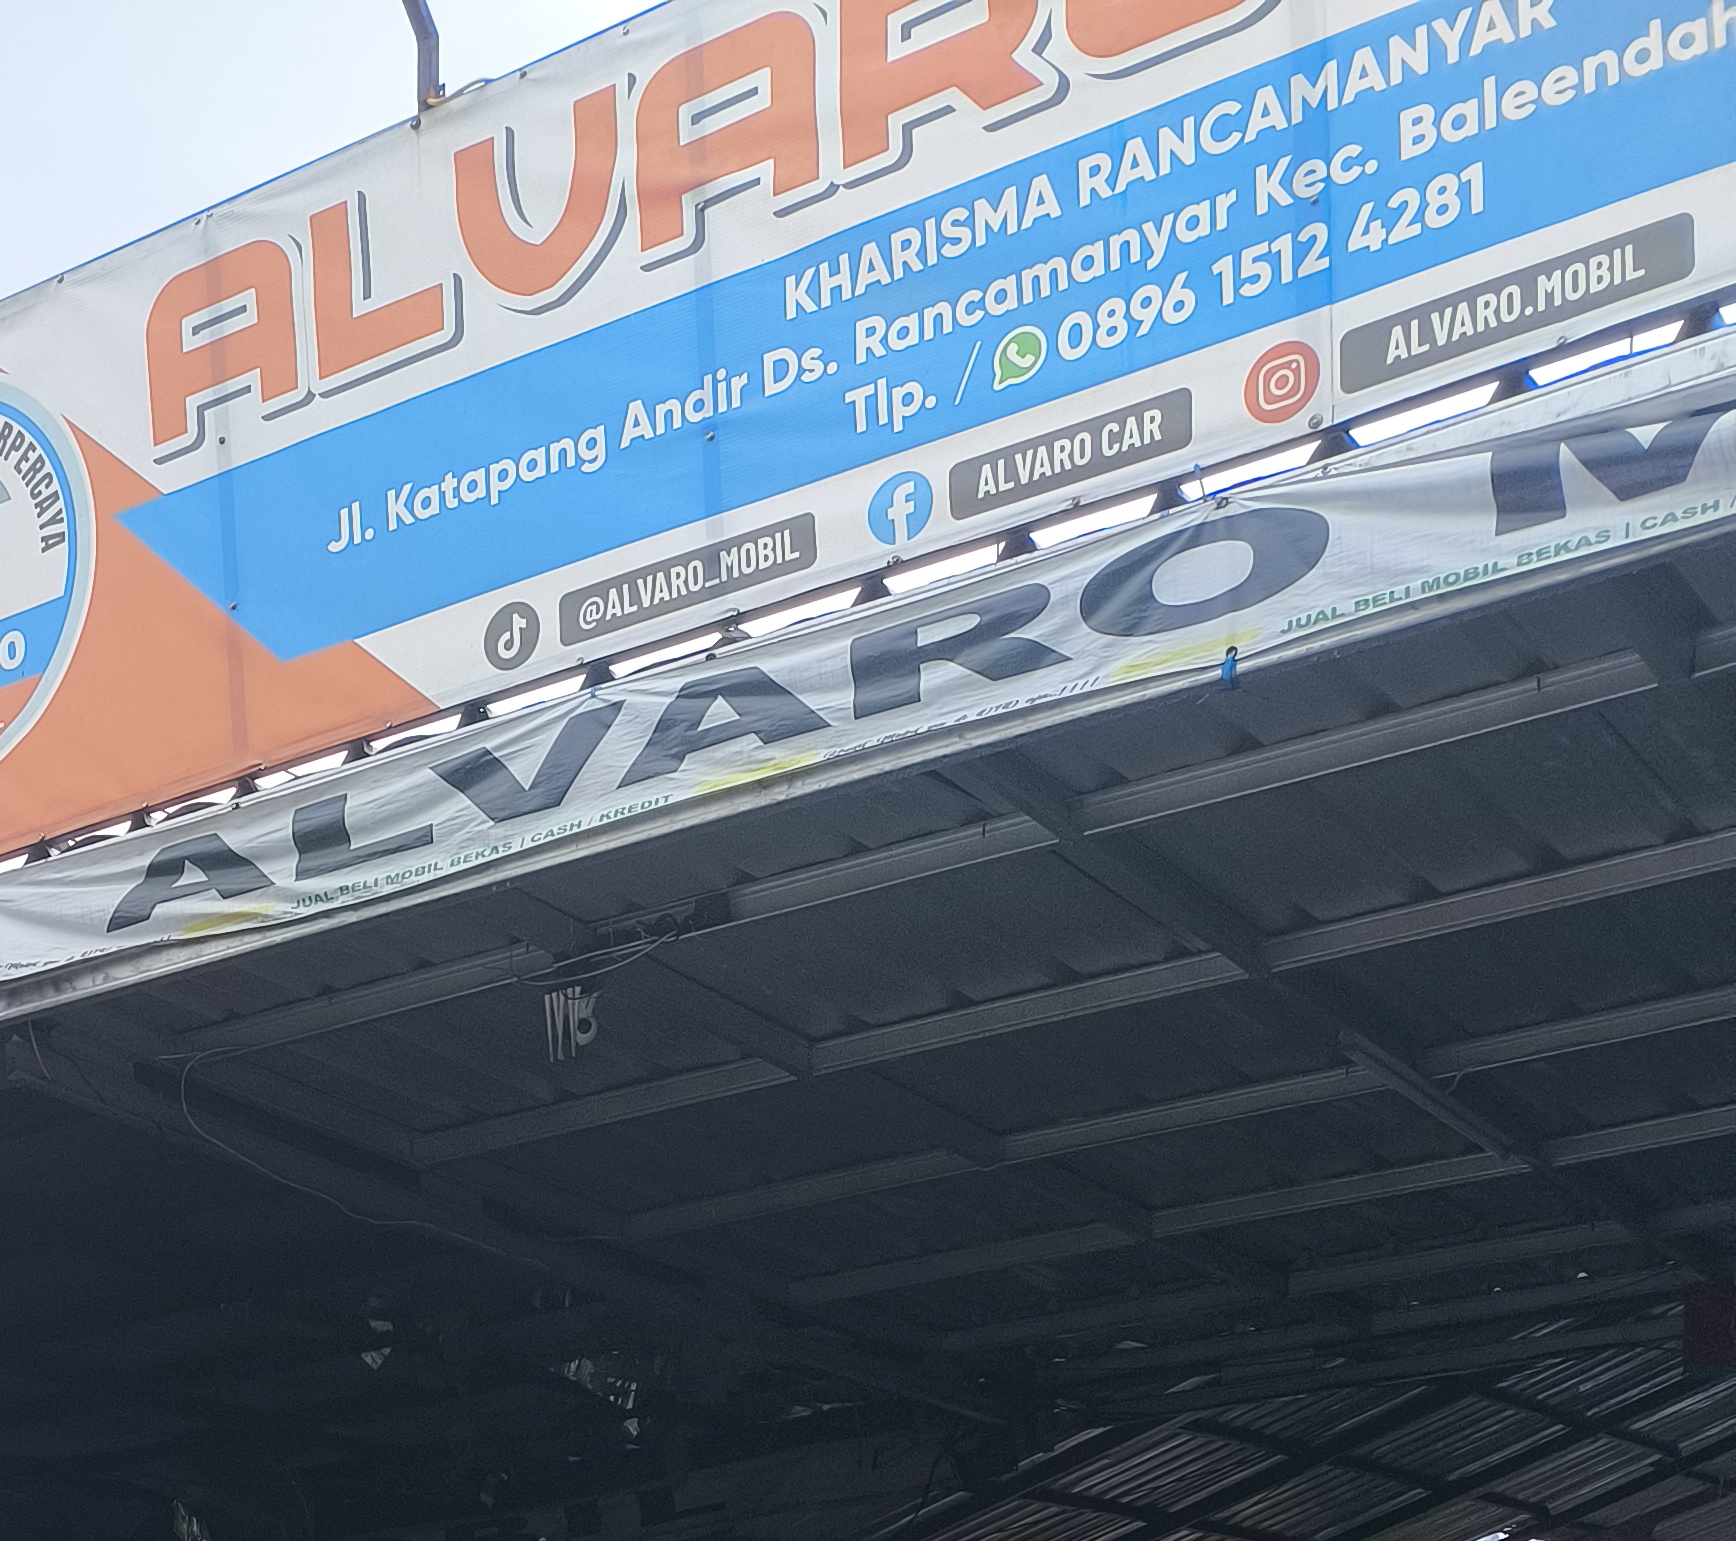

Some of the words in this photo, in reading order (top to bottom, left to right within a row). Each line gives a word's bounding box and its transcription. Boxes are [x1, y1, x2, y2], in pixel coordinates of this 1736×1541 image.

[144, 0, 1274, 466] ALVAR
[783, 172, 1064, 322] KHARISMA
[1076, 0, 1560, 205] RANCAMANYAR
[326, 499, 374, 554] Jl.
[385, 418, 608, 530] Katapang
[617, 367, 750, 450] Andir
[761, 340, 839, 399] Ds.
[854, 180, 1239, 367] Rancamanyar
[1253, 138, 1380, 216] Kec.
[1397, 5, 1736, 160] Baleendah
[845, 371, 938, 435] Tlp.
[1056, 275, 1197, 362] 0896
[1211, 218, 1331, 310] 1512
[1345, 161, 1487, 255] 4281
[1384, 241, 1646, 364] ALVARO.MOBIL
[975, 430, 1093, 500] ALVARO
[1102, 408, 1164, 474] CAR
[577, 527, 801, 632] @ALVARO_MOBIL
[1280, 605, 1346, 635] JUAL
[1354, 584, 1411, 614] BELI
[1420, 560, 1509, 595] MOBIL
[1516, 528, 1612, 567] BEKAS
[1639, 498, 1721, 531] CASH
[106, 505, 1330, 933] ALVARO
[290, 890, 335, 911] JUAL
[339, 878, 381, 899] BELI
[384, 860, 445, 888] MOBIL
[449, 841, 514, 869] BEKAS
[530, 816, 583, 844] CASH
[599, 793, 674, 824] KREDIT
